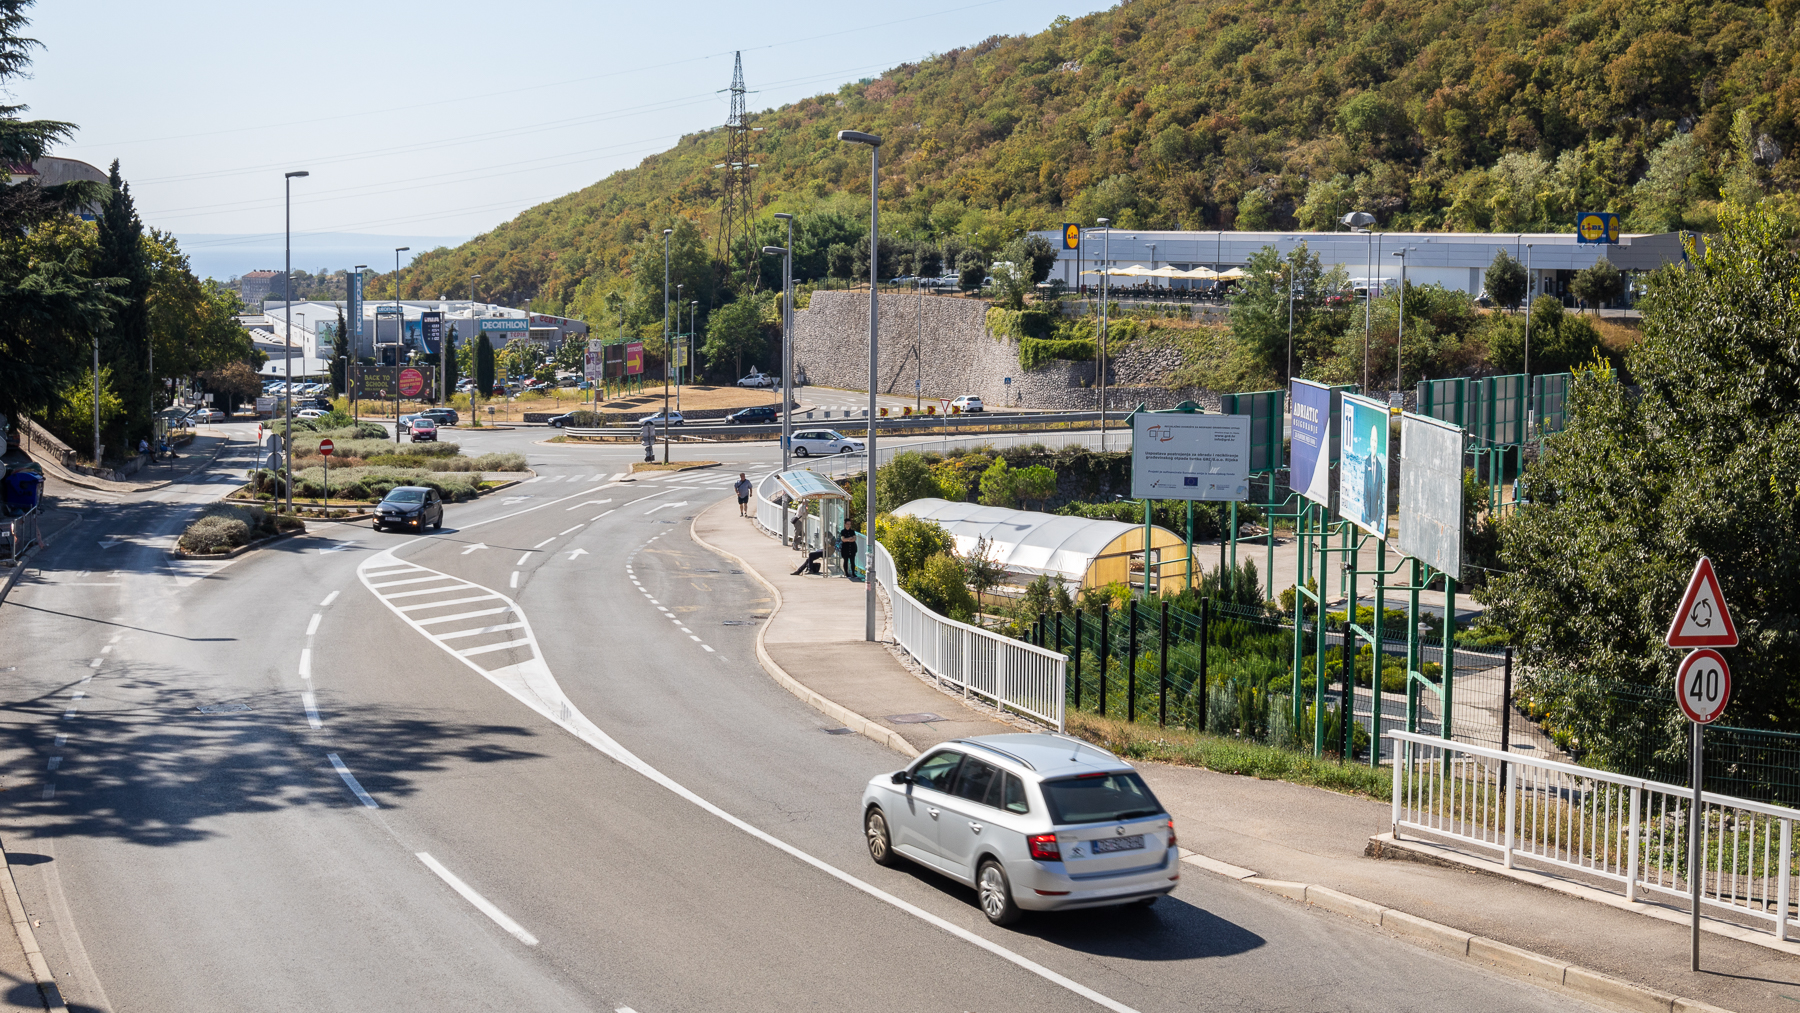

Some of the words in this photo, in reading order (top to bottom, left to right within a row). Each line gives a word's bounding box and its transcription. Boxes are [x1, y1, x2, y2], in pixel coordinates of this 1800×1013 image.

[482, 321, 527, 329] DECATHLON
[1293, 402, 1319, 424] ADRIATIC
[1690, 669, 1719, 703] 40
